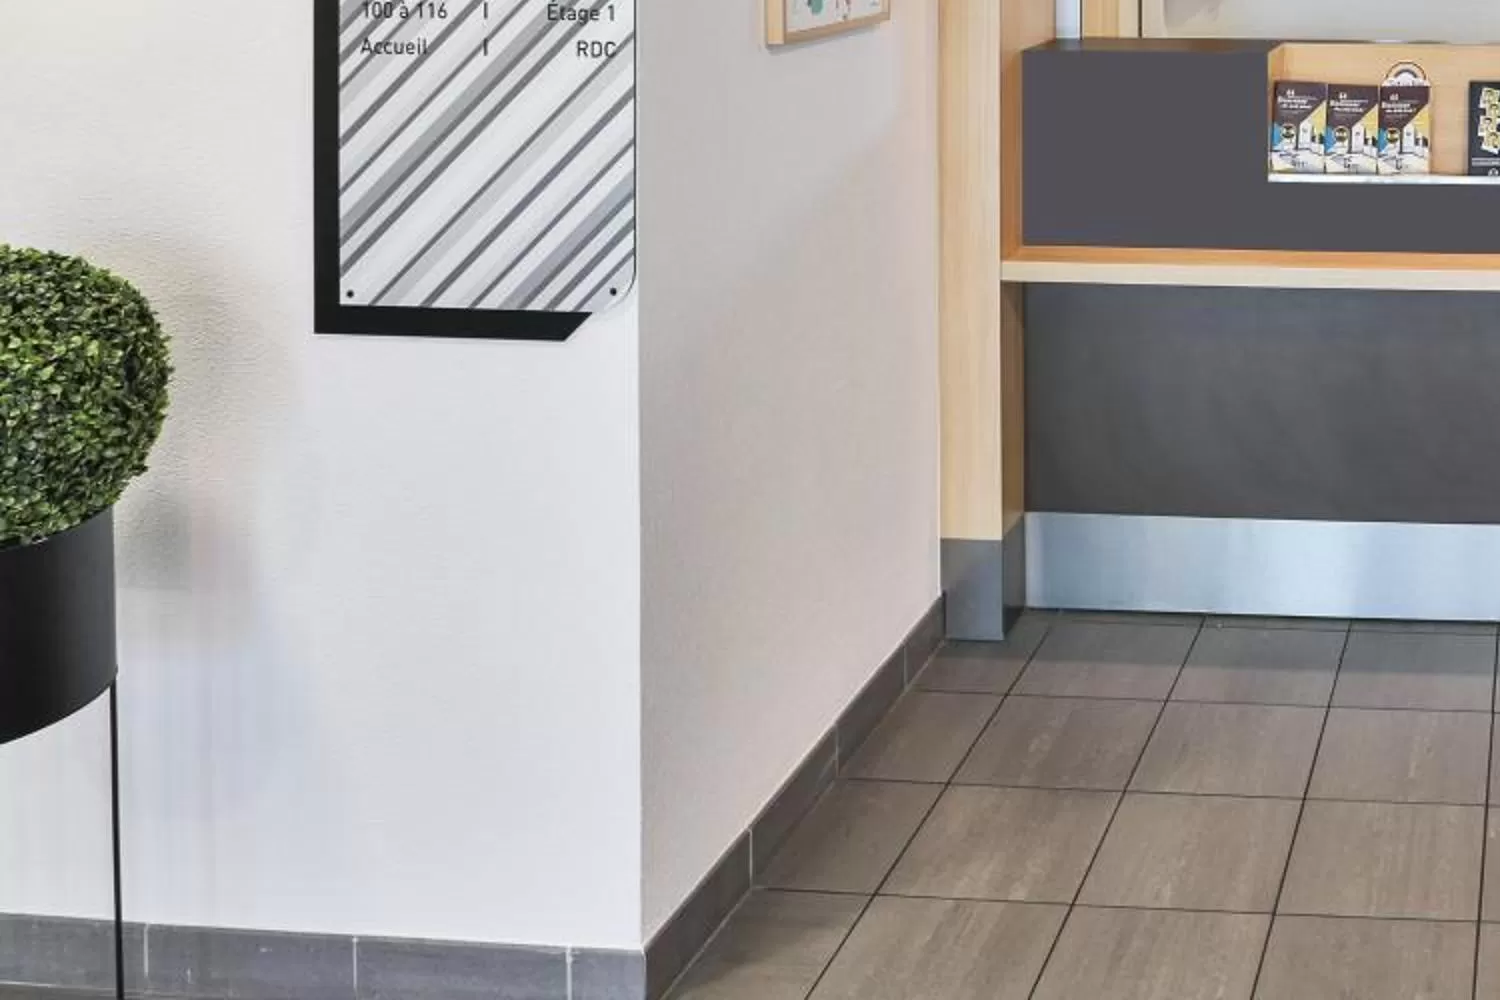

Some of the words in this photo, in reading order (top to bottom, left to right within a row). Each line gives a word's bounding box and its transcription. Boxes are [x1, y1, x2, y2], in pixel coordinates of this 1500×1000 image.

[363, 2, 394, 19] 100
[399, 1, 410, 19] à
[417, 2, 448, 19] 116
[607, 4, 615, 21] 1
[360, 37, 428, 55] Accueil
[576, 41, 617, 58] RDC
